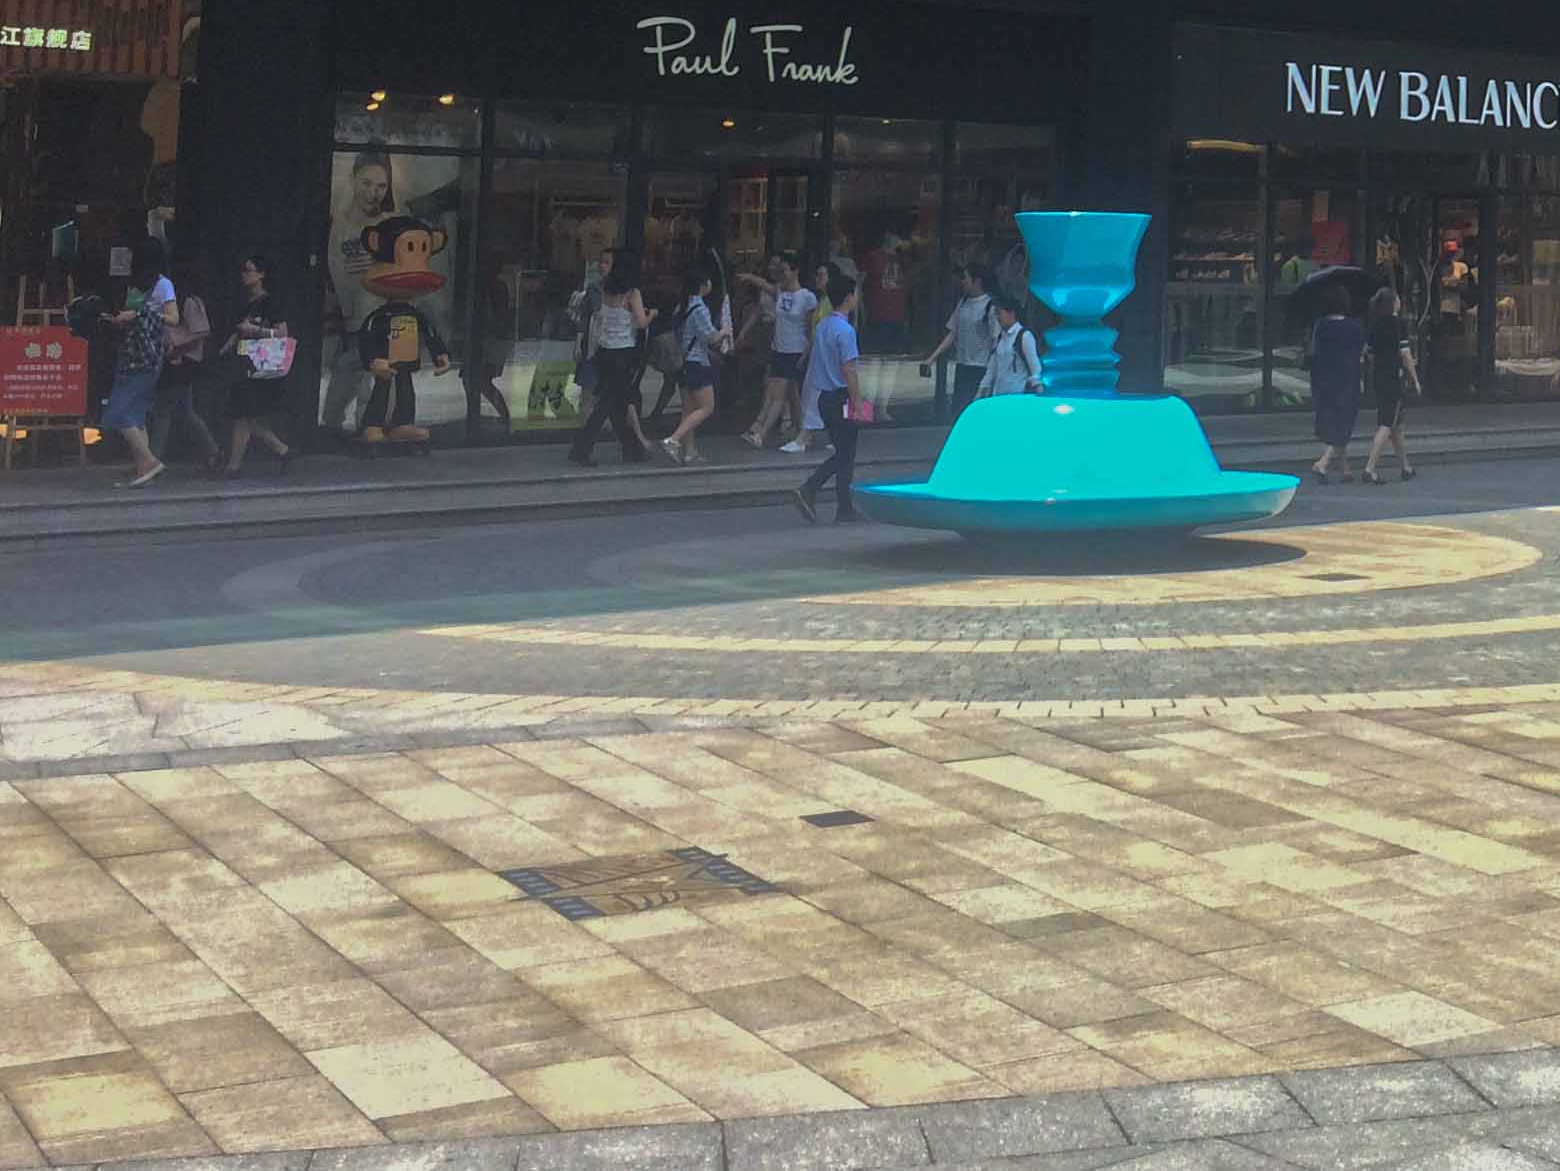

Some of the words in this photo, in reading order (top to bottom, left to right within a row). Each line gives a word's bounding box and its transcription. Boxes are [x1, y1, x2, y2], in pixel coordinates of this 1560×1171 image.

[636, 16, 740, 77] Paul
[750, 24, 859, 85] Frank
[1285, 62, 1386, 118] NEW
